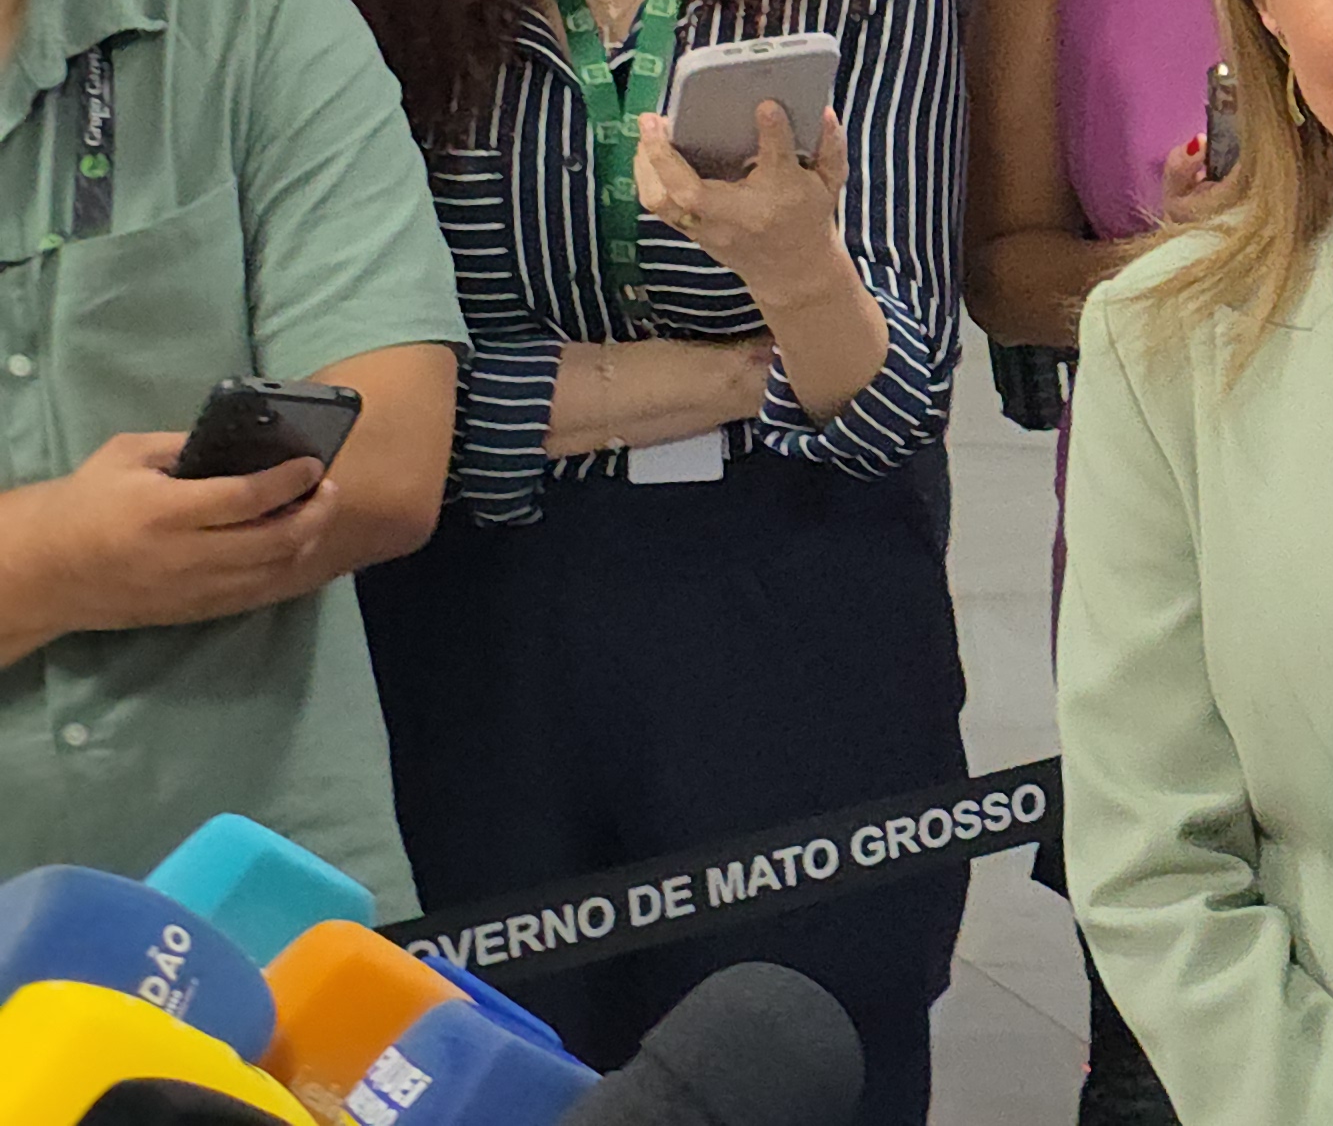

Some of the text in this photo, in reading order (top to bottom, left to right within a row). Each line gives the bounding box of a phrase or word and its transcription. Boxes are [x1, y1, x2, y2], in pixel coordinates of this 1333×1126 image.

[627, 874, 697, 927] DE
[706, 838, 840, 908] MATO
[850, 783, 1047, 867] GROSSO
